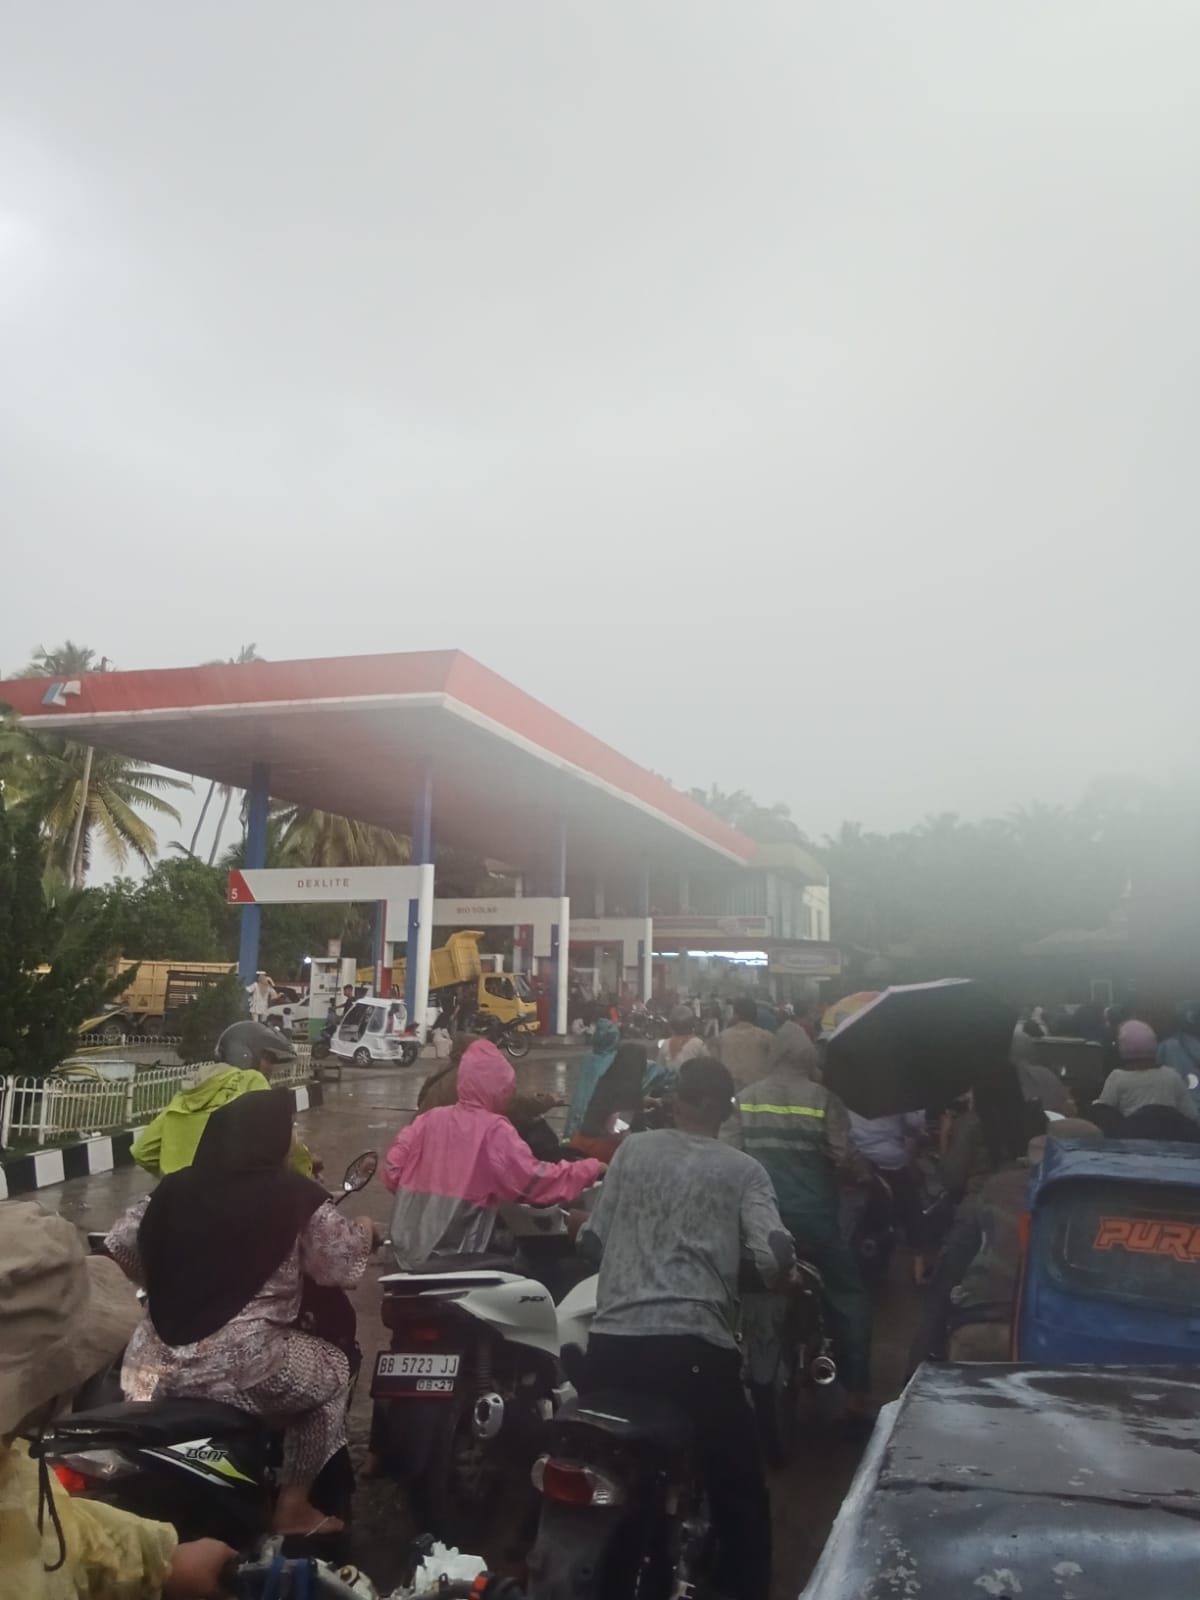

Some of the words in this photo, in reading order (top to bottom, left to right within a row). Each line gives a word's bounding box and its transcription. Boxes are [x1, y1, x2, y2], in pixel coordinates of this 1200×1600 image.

[297, 878, 349, 888] DEXLITE
[231, 888, 238, 900] 5
[380, 1358, 395, 1373] BB
[402, 1358, 433, 1373] 5723
[441, 1358, 457, 1373] JJ
